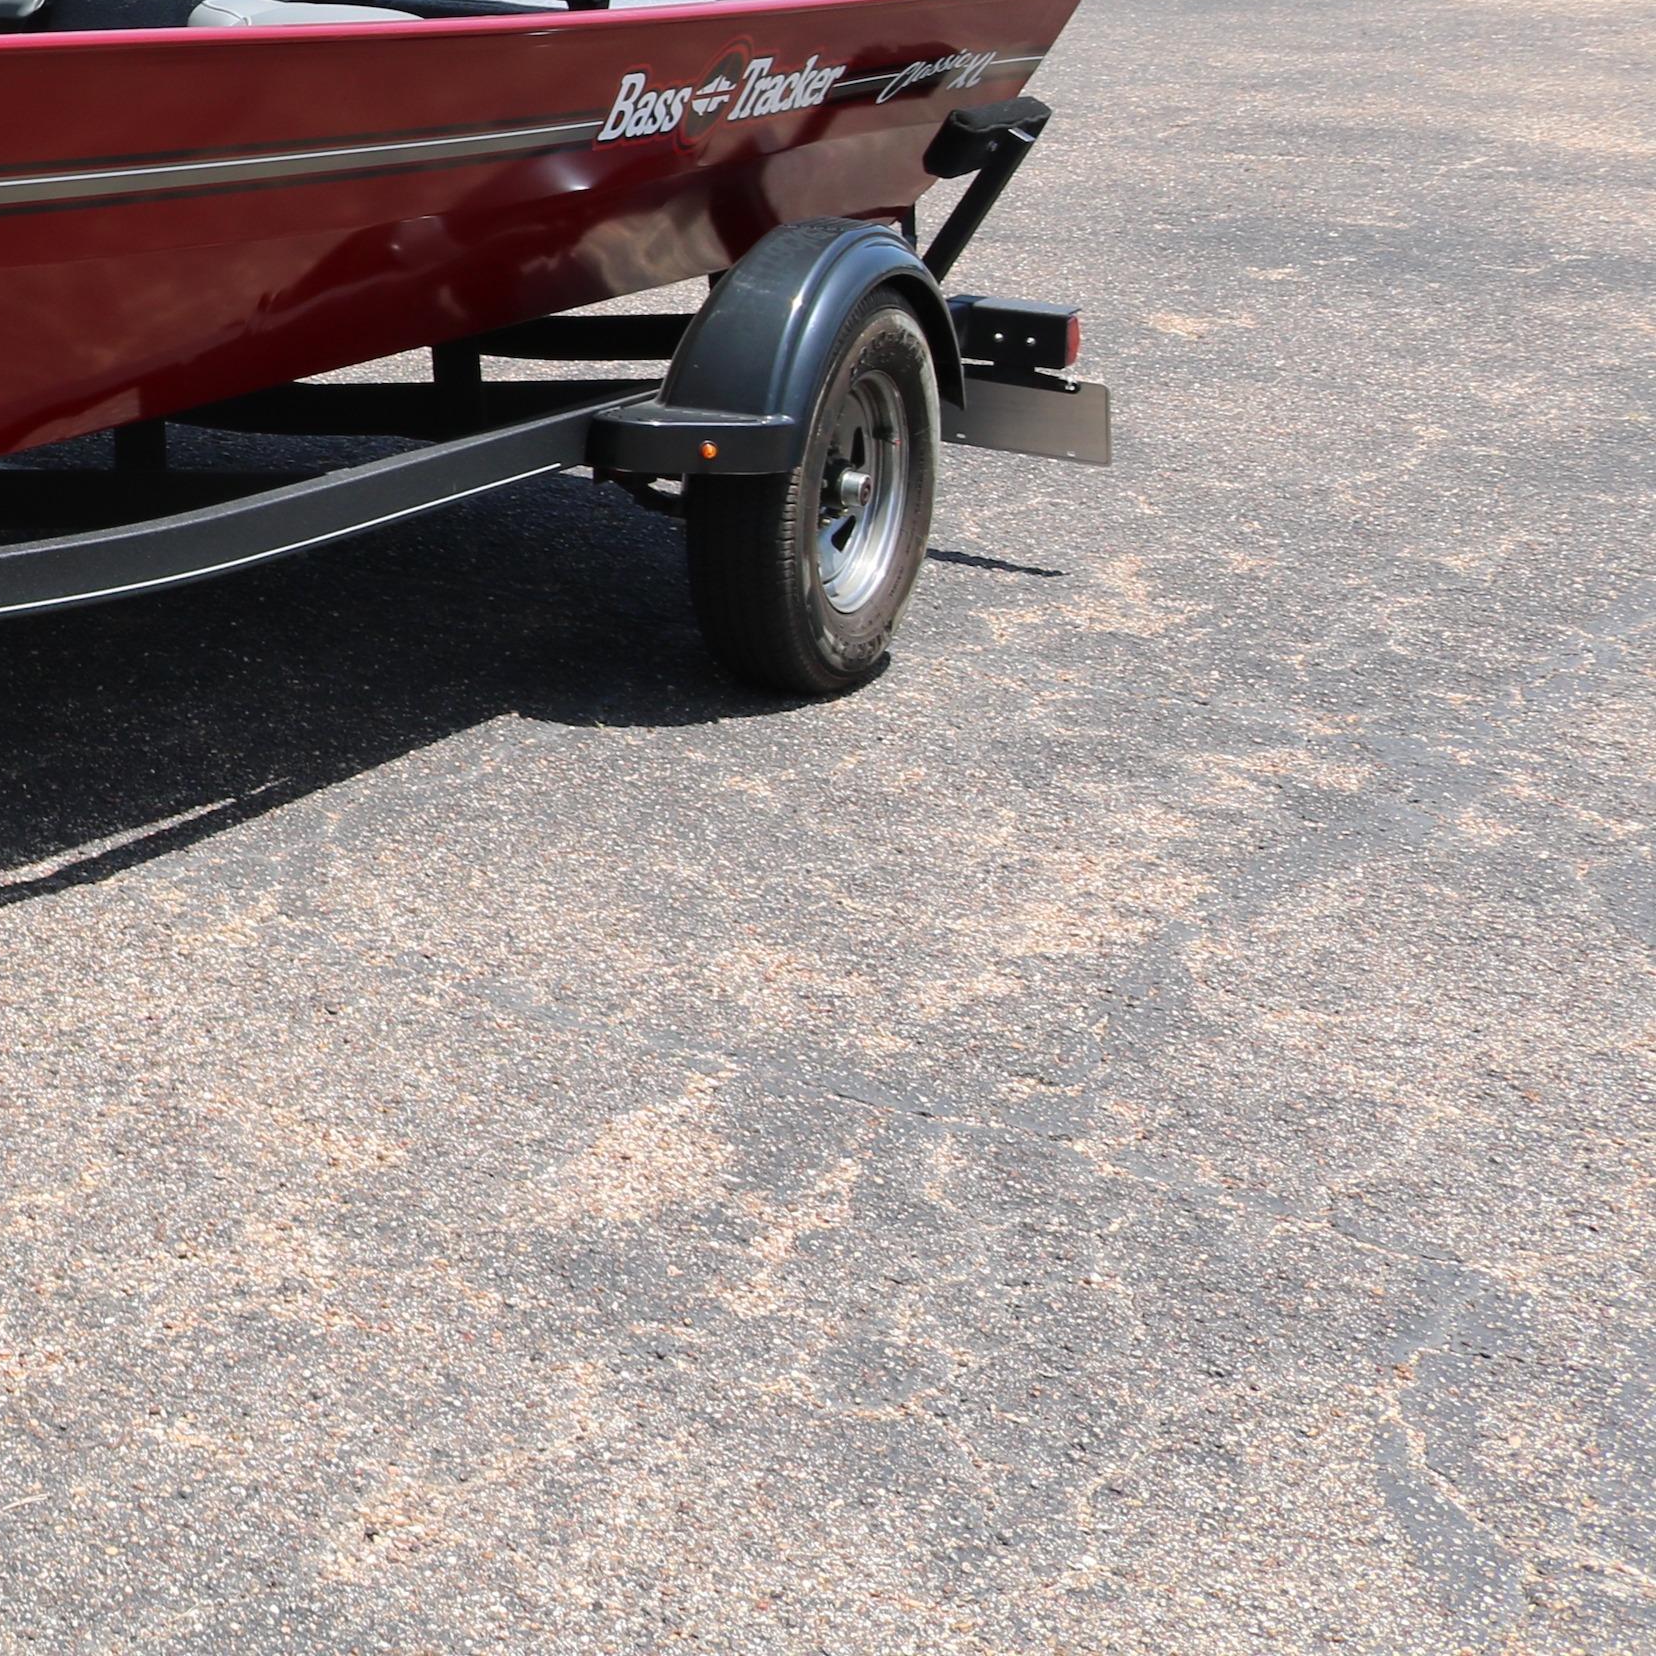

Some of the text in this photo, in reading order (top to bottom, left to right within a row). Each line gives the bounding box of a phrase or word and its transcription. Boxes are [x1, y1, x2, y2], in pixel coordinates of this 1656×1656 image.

[598, 55, 846, 142] Bass Tracker
[875, 48, 997, 104] Classic XL
